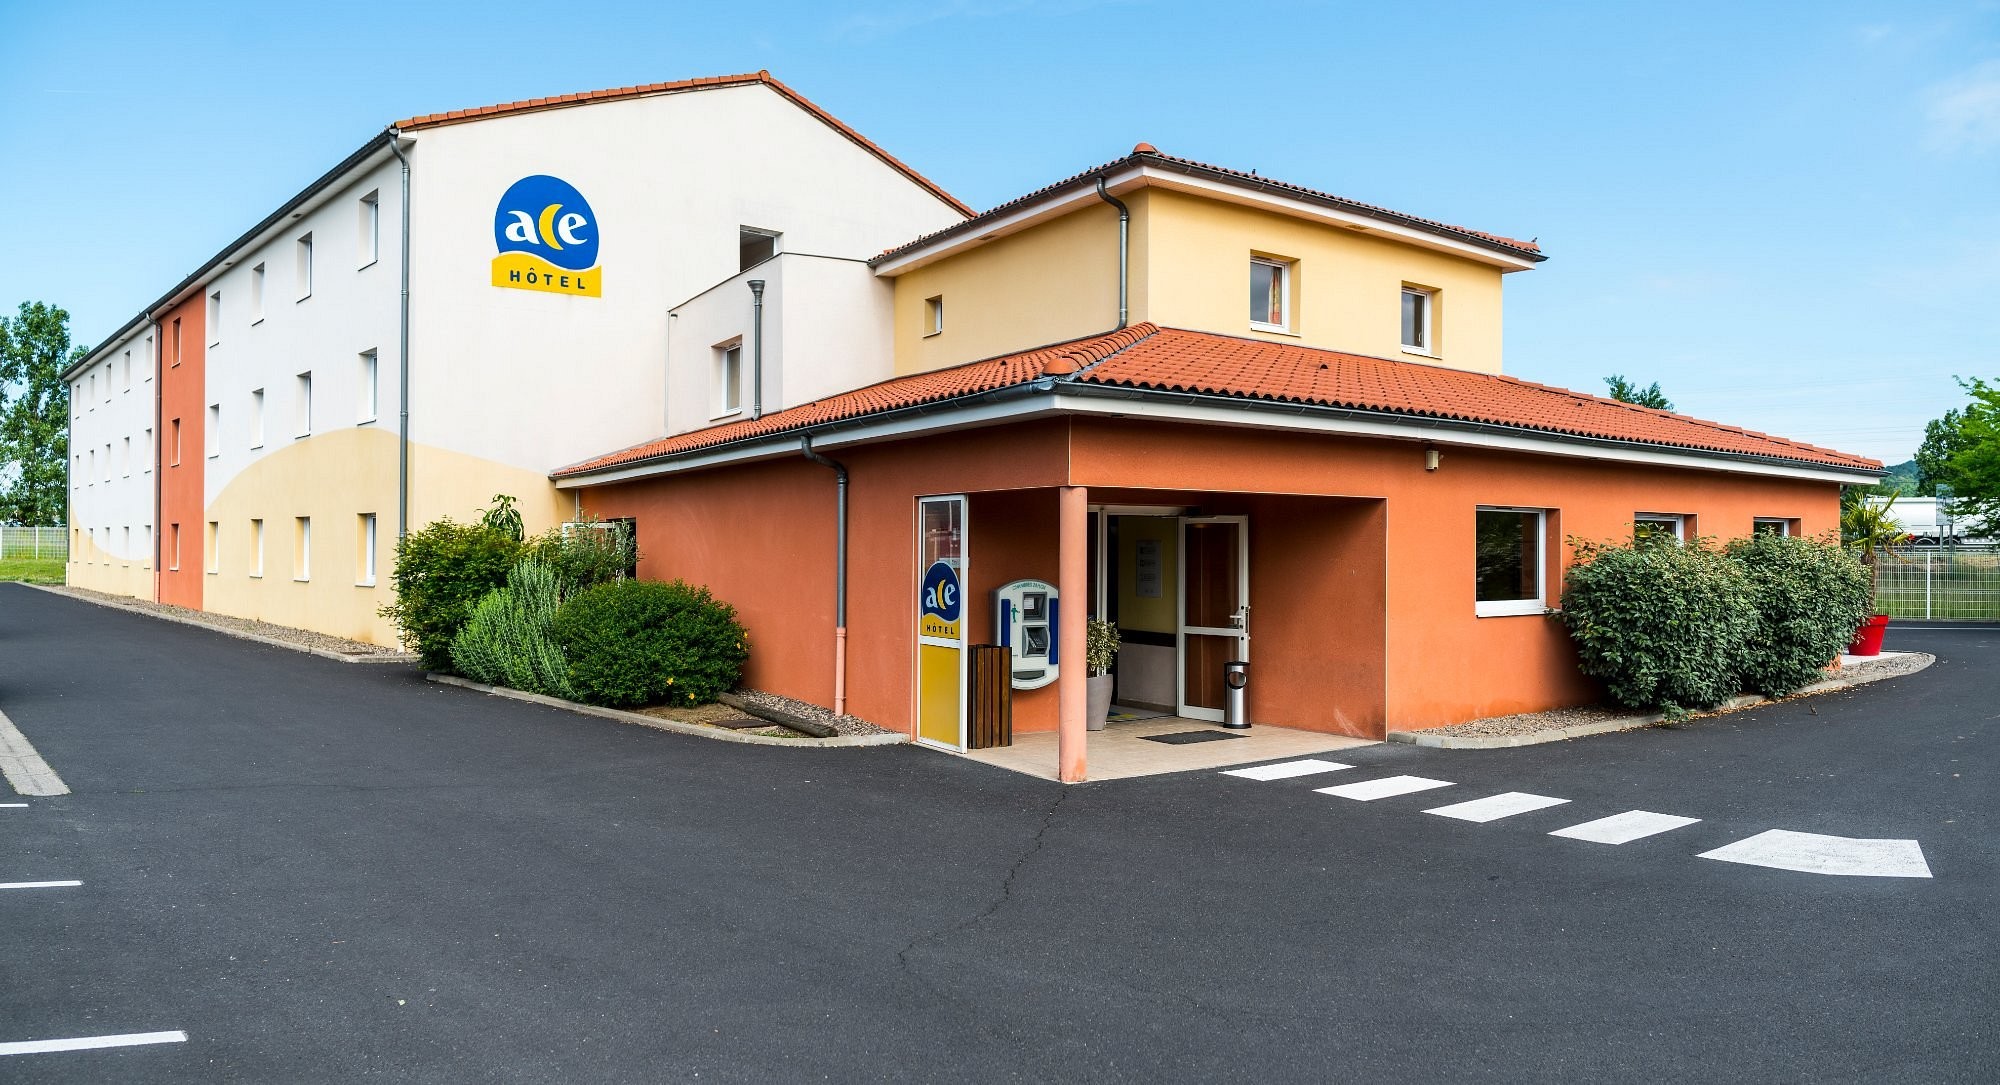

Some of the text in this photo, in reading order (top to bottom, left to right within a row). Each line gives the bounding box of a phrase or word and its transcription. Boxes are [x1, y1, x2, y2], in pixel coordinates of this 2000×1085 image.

[505, 203, 588, 251] ace
[509, 267, 586, 290] HÔTEL
[925, 579, 956, 610] ace
[926, 622, 955, 635] HÔTEL
